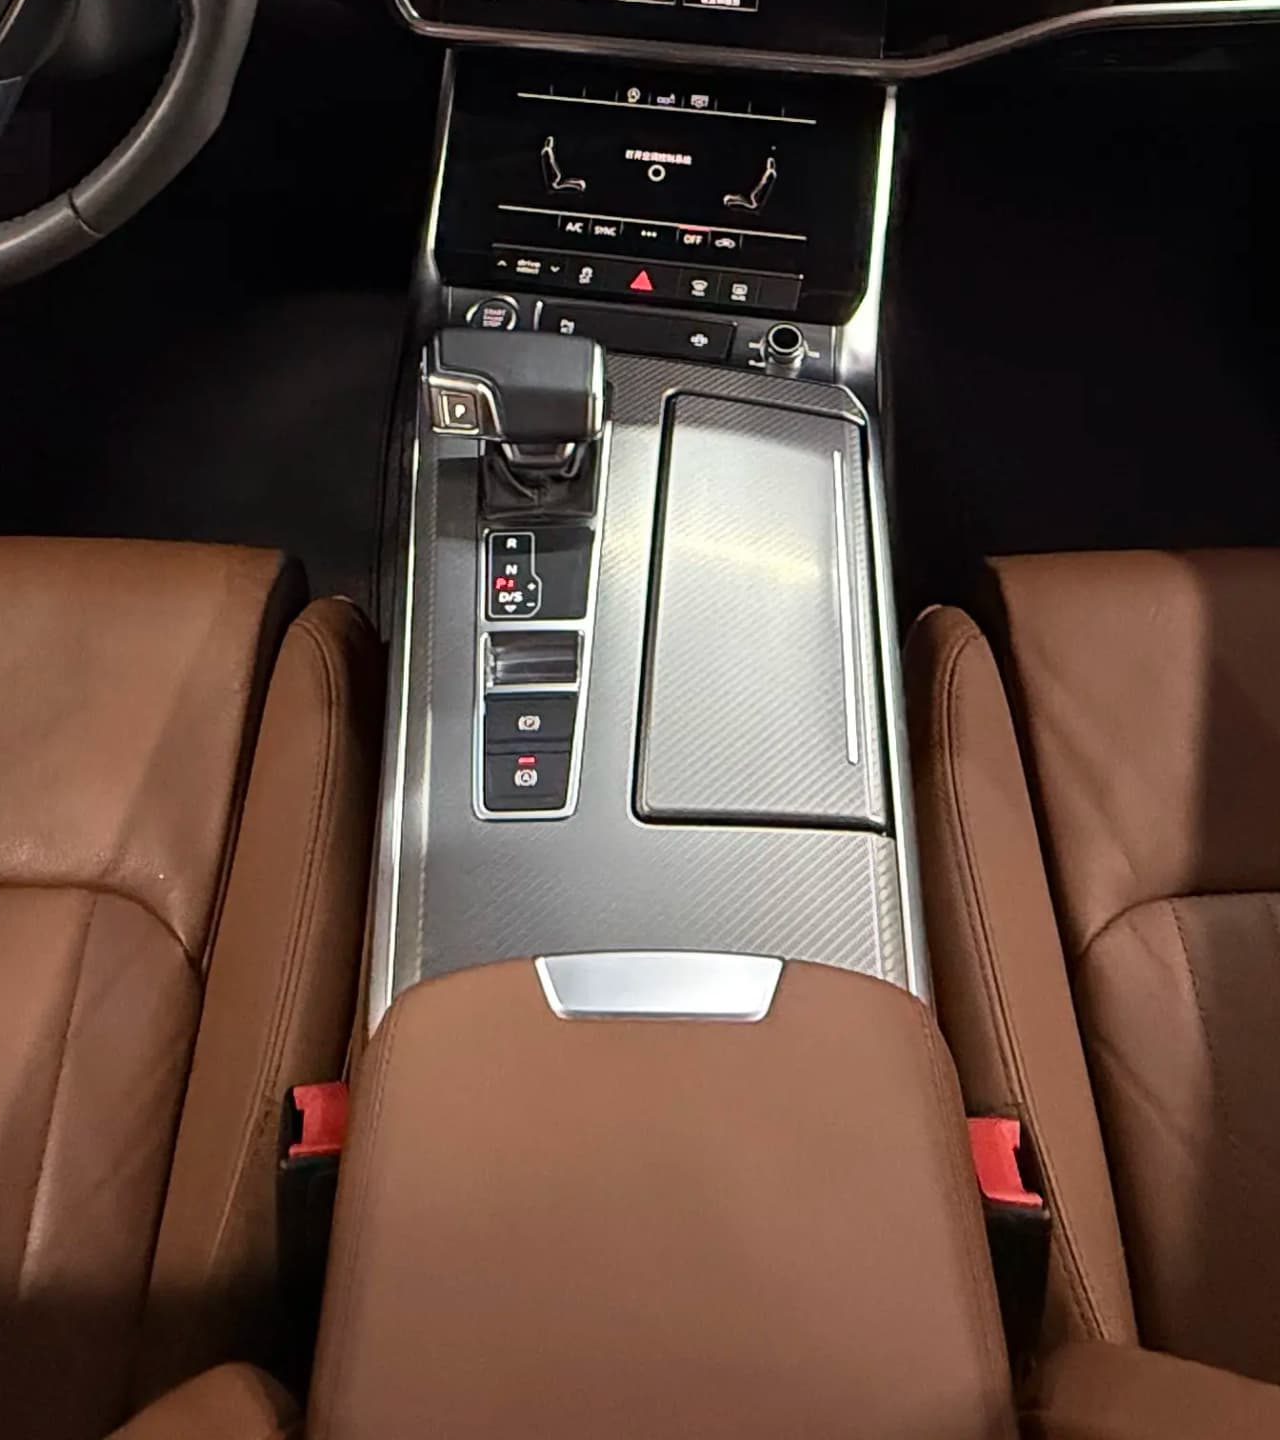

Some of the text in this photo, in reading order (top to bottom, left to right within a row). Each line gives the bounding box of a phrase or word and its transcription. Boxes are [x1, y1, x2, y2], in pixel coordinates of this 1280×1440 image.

[565, 221, 585, 234] A/C
[593, 225, 617, 237] SYNC
[683, 232, 704, 246] OFF
[506, 537, 518, 550] R
[505, 564, 518, 576] N
[498, 591, 524, 605] D/S
